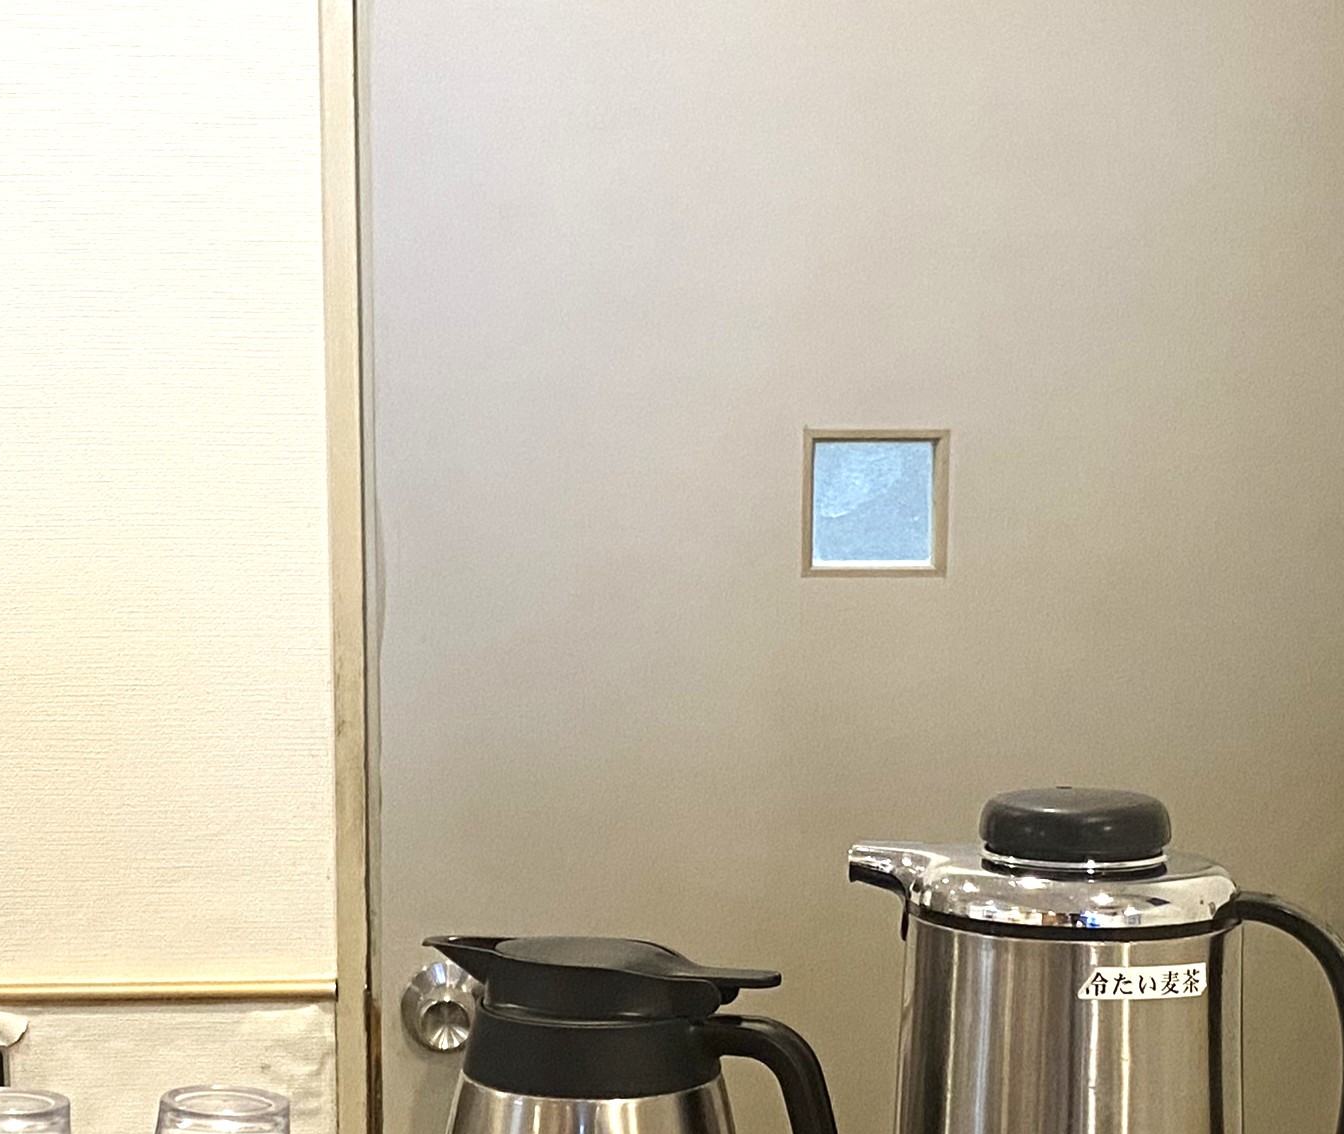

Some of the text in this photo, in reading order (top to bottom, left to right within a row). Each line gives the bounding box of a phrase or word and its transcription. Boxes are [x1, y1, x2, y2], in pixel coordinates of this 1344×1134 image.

[1086, 968, 1201, 997] 冷たい麦茶
